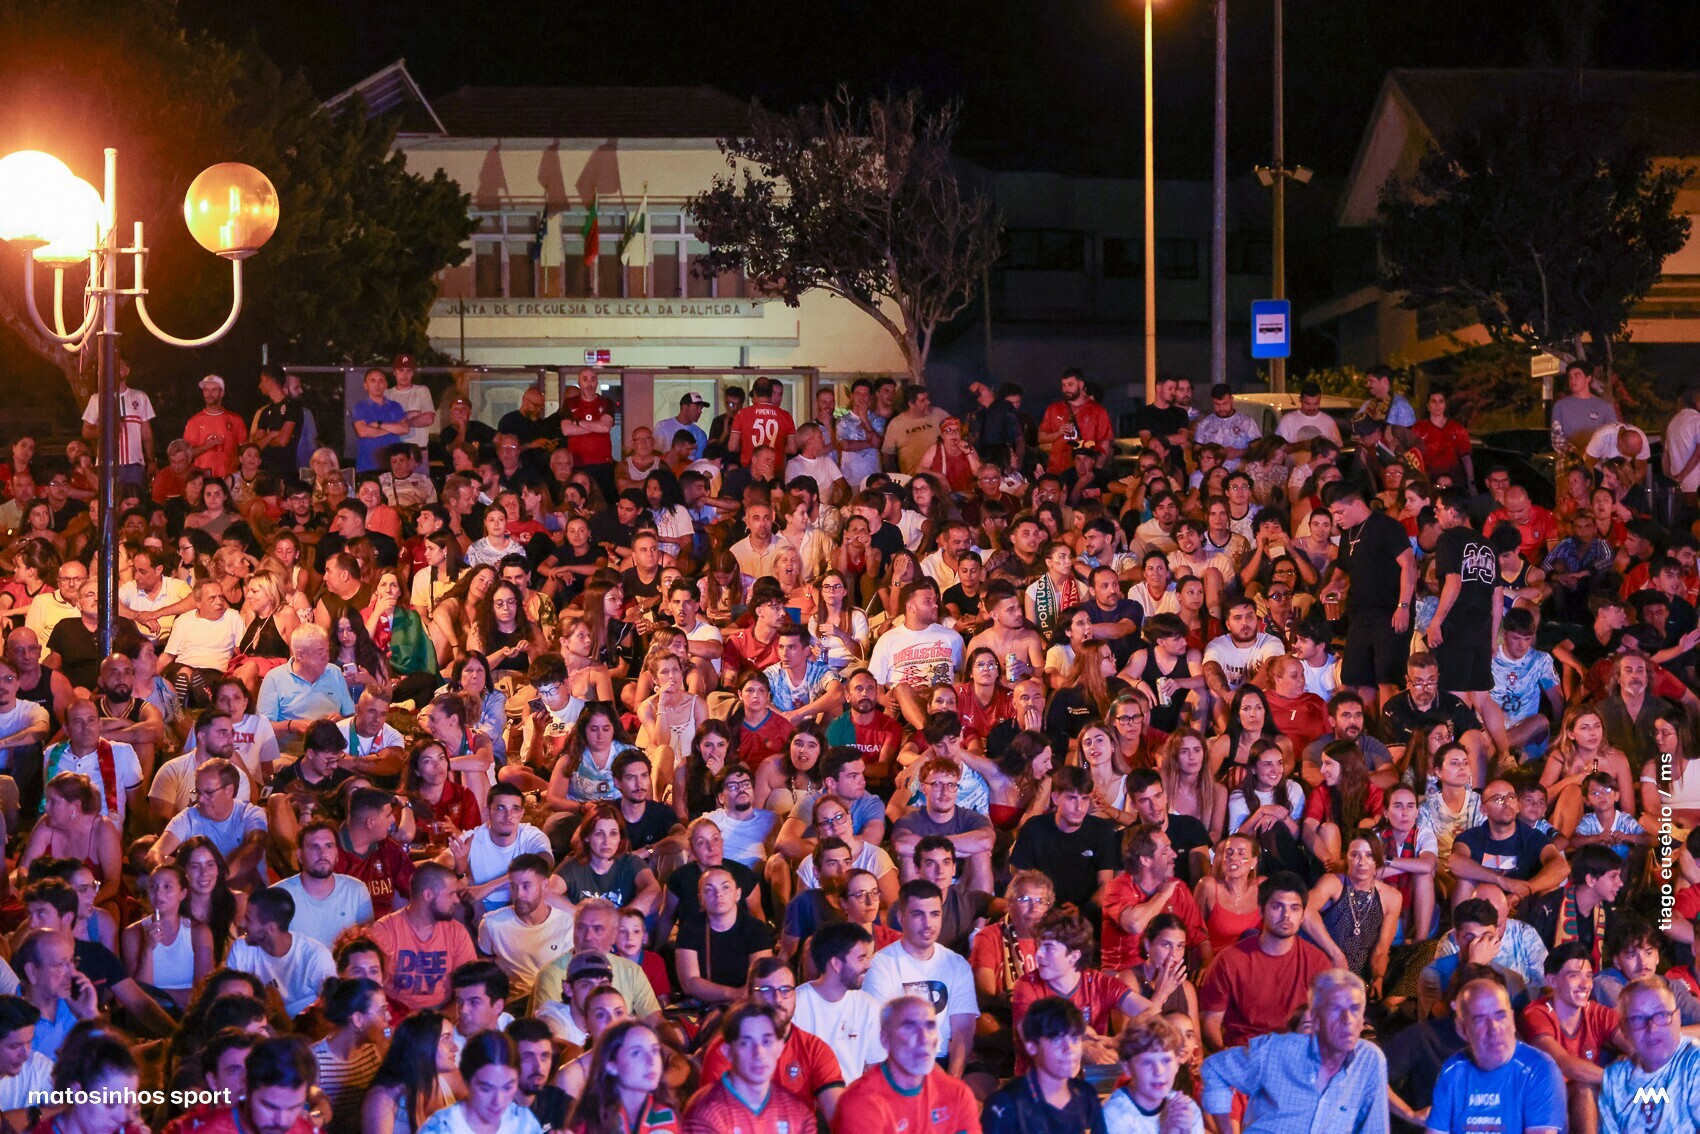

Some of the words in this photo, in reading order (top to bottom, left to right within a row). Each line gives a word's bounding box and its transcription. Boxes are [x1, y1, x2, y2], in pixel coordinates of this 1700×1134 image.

[446, 304, 486, 315] JUNTA
[494, 304, 509, 315] DE
[517, 304, 587, 315] FREGUESIA
[594, 304, 610, 315] DE
[658, 304, 673, 315] DA
[681, 304, 740, 315] PALMEIRA
[752, 418, 779, 448] 59
[397, 949, 447, 974] DEE
[393, 973, 444, 995] PLY
